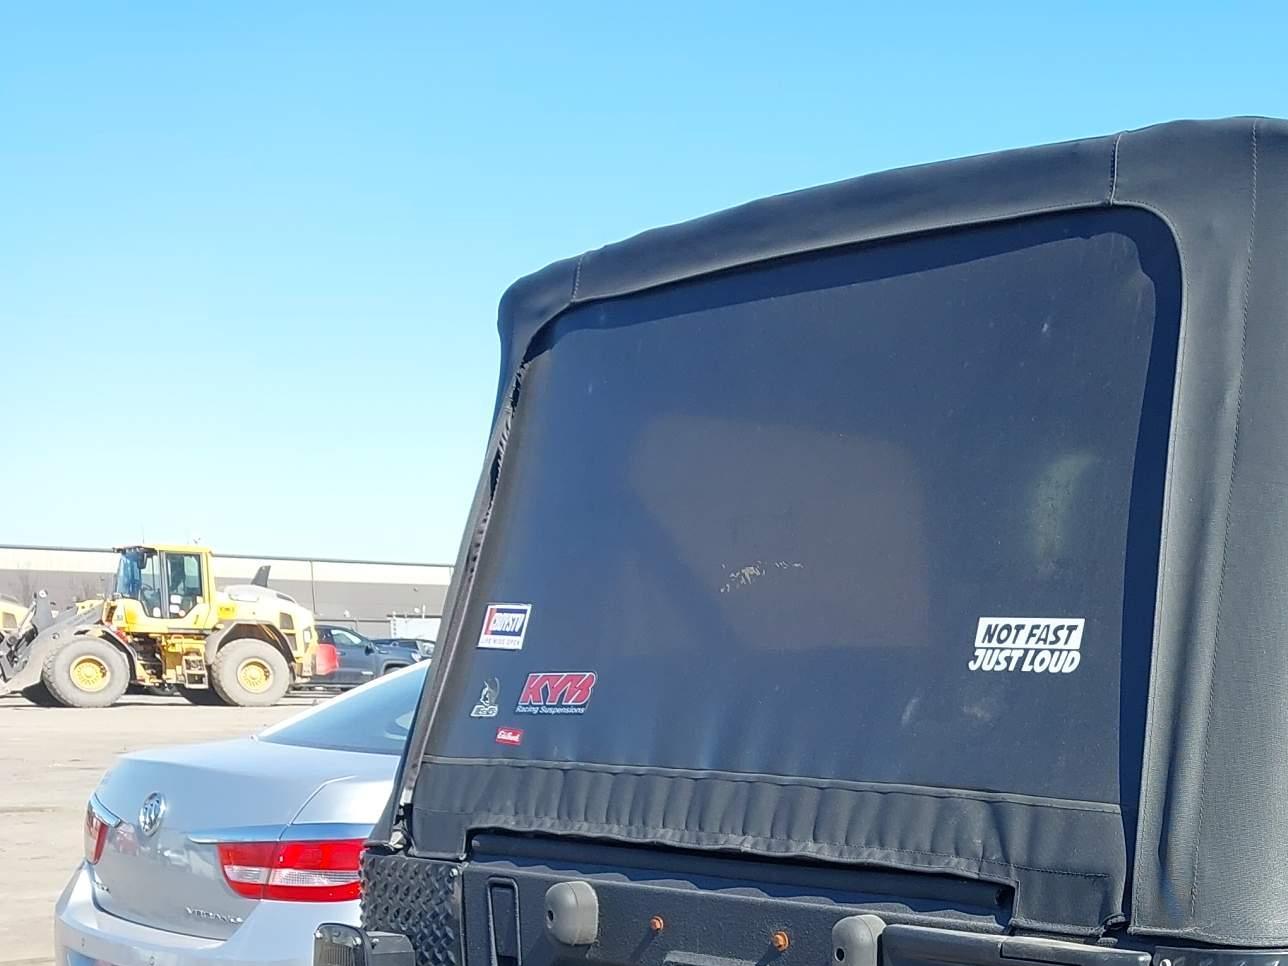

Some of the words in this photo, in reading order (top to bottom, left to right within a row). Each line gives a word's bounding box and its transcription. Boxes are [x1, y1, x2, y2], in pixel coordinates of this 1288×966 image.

[981, 623, 1025, 645] NOT
[1025, 624, 1079, 646] FAST
[968, 648, 1025, 671] JUST
[1021, 649, 1081, 673] LOUD
[518, 672, 597, 706] KYB
[515, 705, 539, 715] Racing
[540, 705, 585, 715] Suspensions
